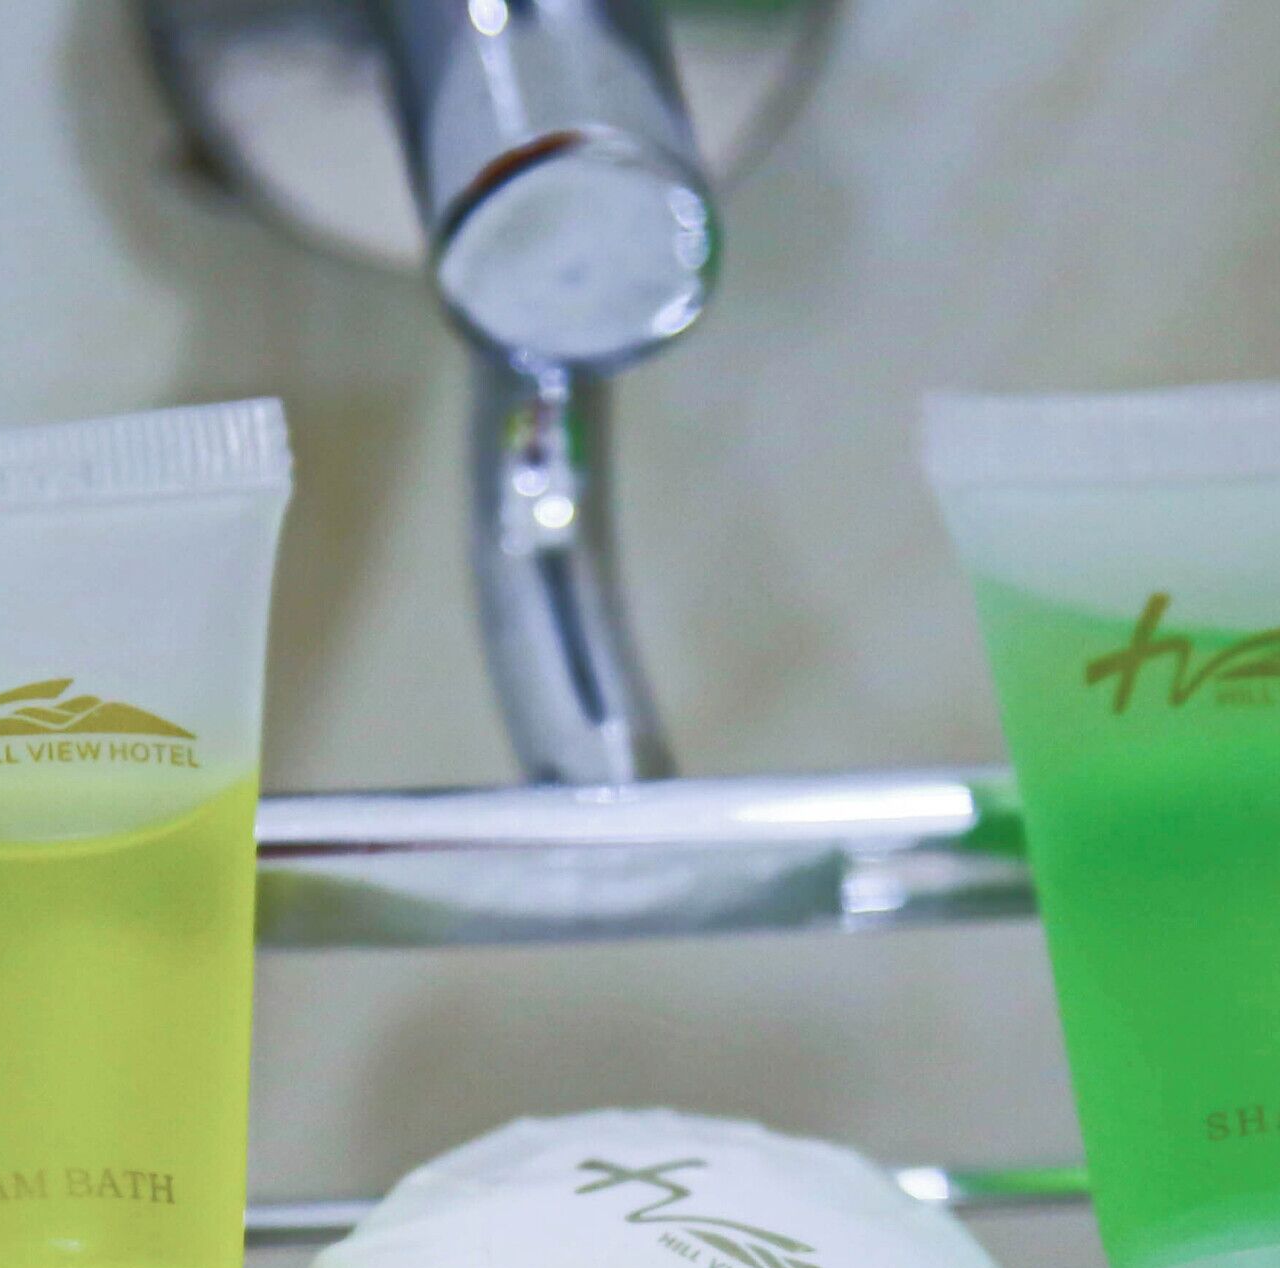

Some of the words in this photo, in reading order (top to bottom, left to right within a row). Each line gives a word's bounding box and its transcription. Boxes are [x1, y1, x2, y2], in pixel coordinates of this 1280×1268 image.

[27, 740, 103, 763] VIEW
[109, 741, 201, 769] HOTEL
[65, 1166, 176, 1205] BATH
[658, 1232, 701, 1263] HILL
